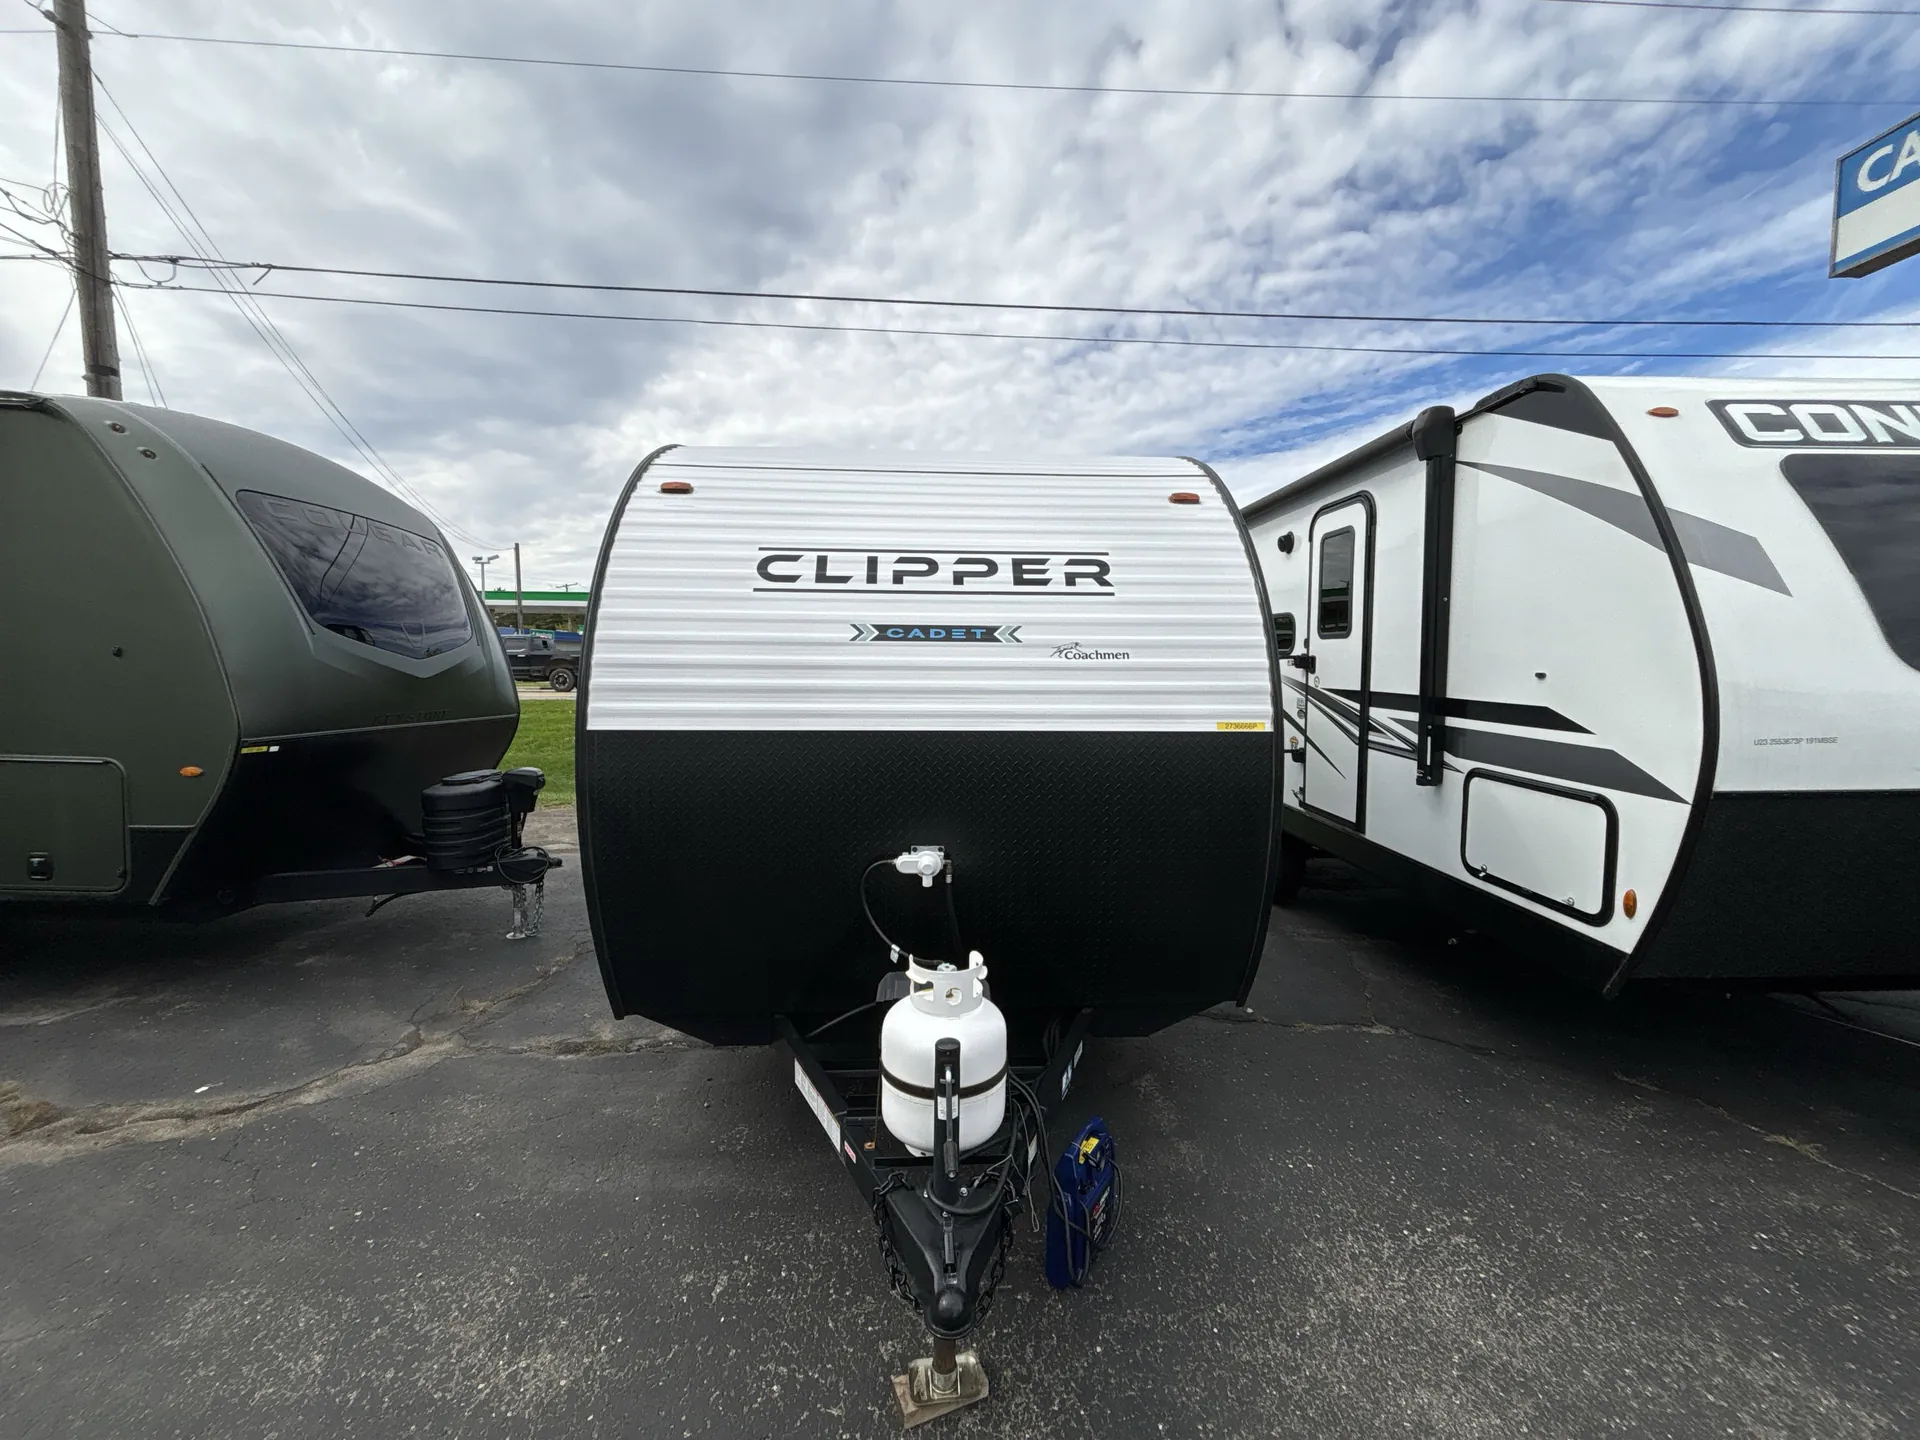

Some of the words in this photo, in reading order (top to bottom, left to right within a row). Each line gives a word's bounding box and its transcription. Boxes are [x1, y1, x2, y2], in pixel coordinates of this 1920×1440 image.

[1857, 129, 1920, 192] CA
[1724, 403, 1920, 443] CON
[756, 554, 1114, 587] CLIPPER
[886, 626, 987, 640] CADET
[1064, 650, 1130, 660] Coachmen
[1753, 738, 1768, 746] U23
